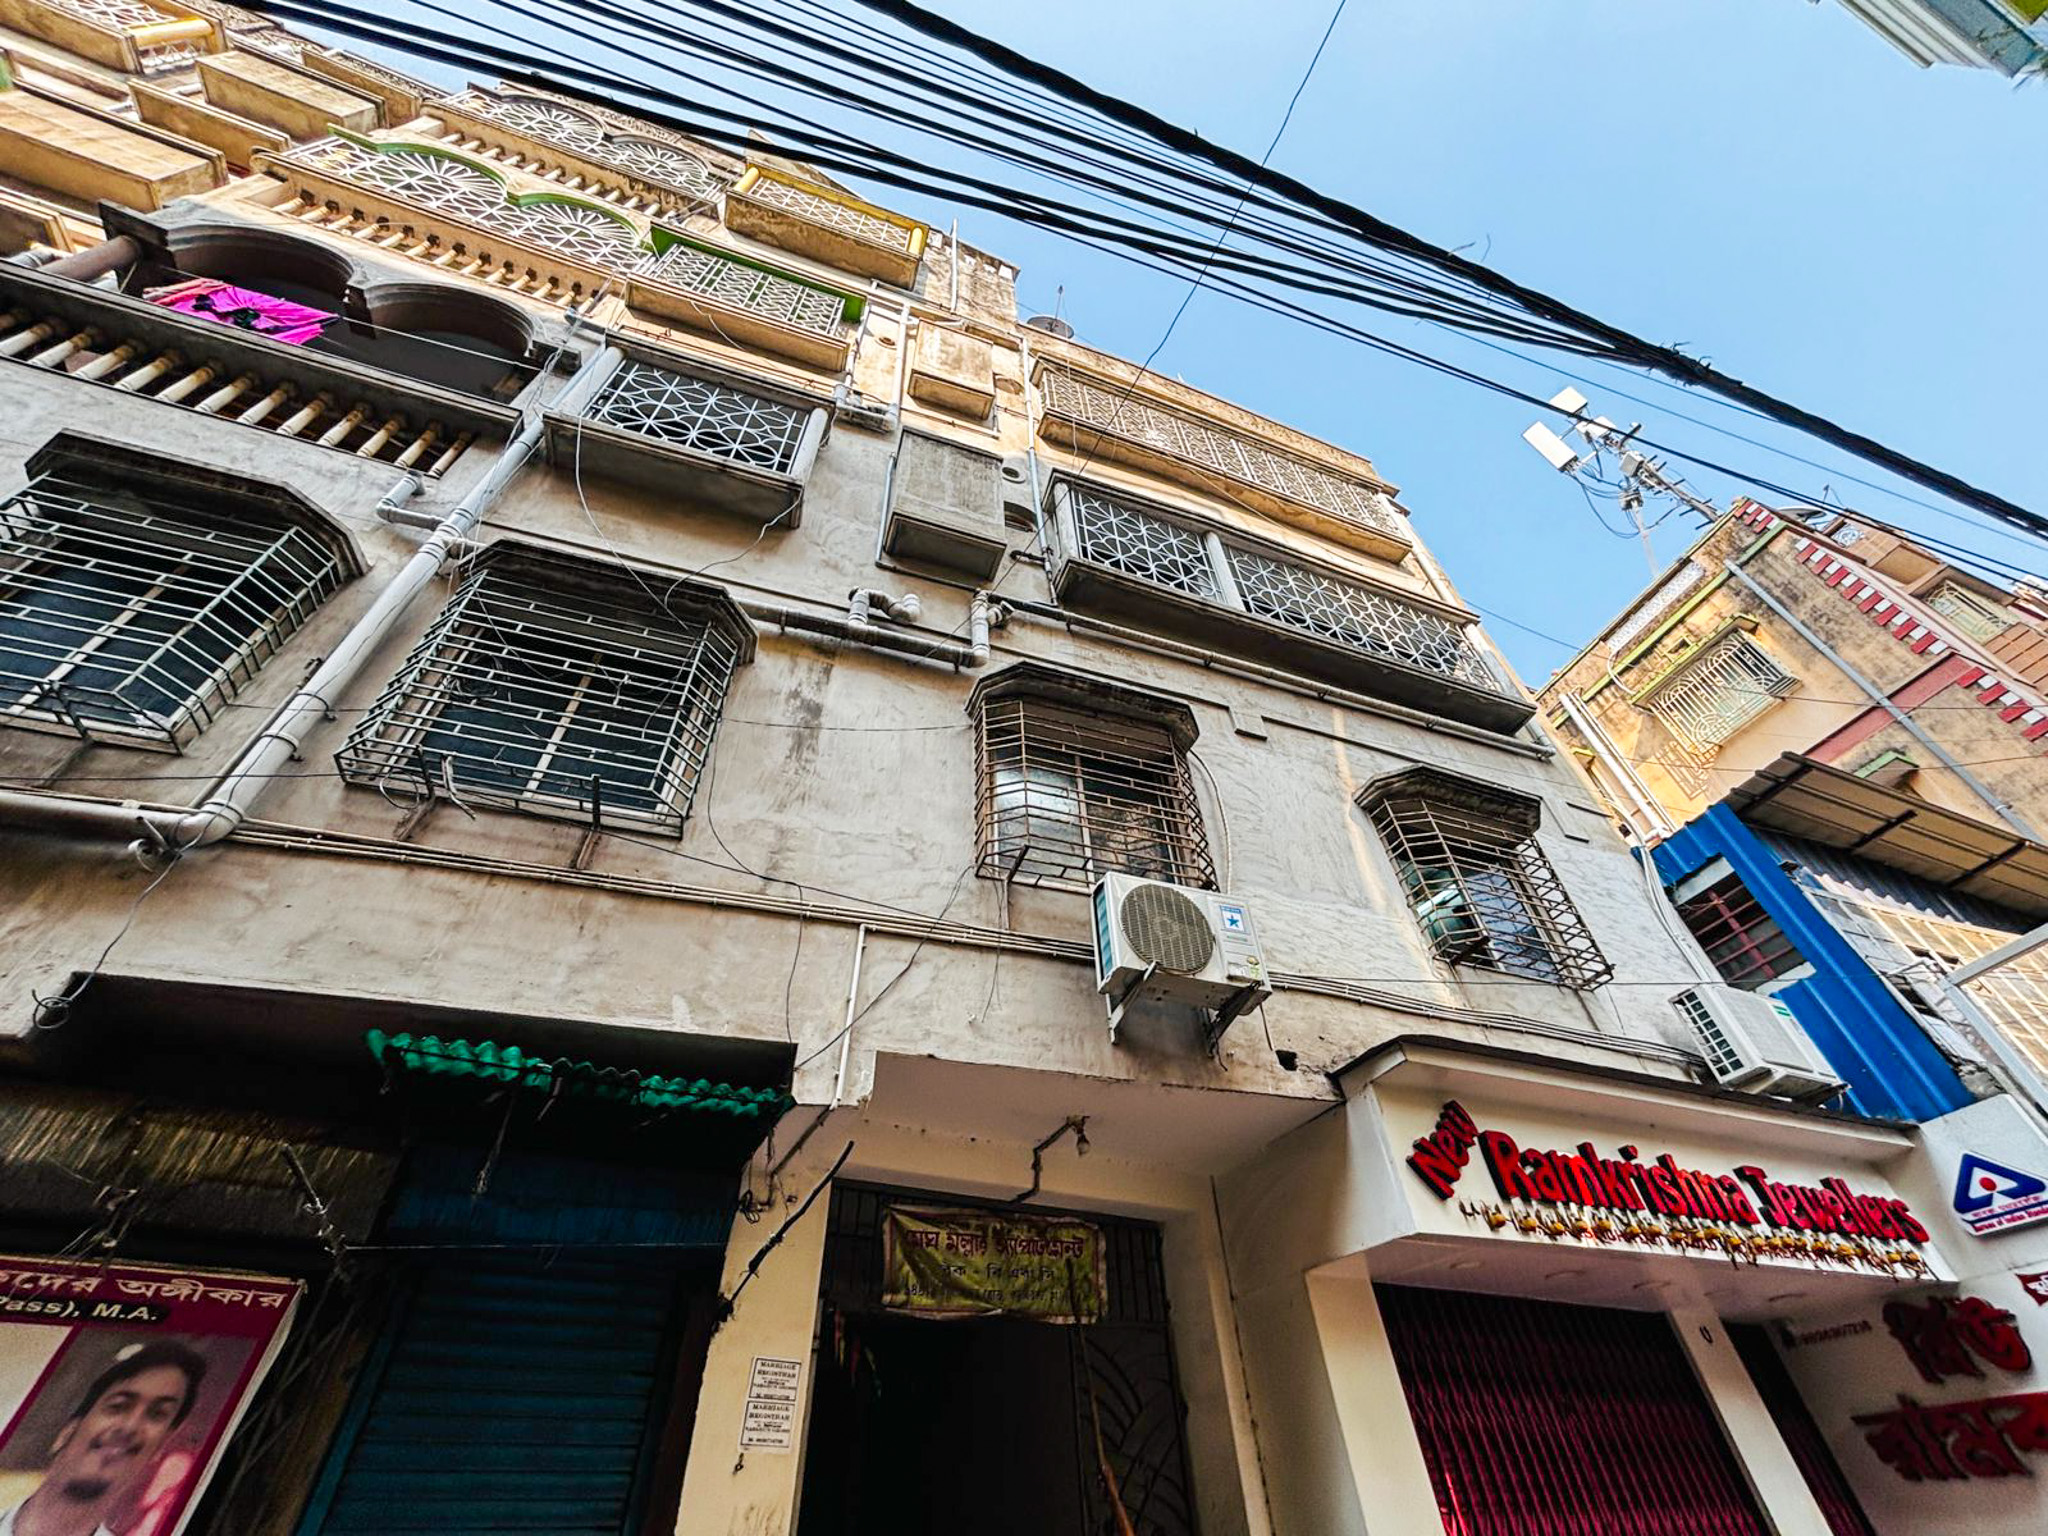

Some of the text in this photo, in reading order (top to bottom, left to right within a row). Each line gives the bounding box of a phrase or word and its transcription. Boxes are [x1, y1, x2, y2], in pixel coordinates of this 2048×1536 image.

[1405, 1100, 1478, 1201] New
[1478, 1130, 1760, 1225] Ramkrishna
[1733, 1165, 1931, 1243] Jewellers
[115, 1278, 288, 1308] অঙ্গীকার
[92, 1302, 157, 1320] M.A.
